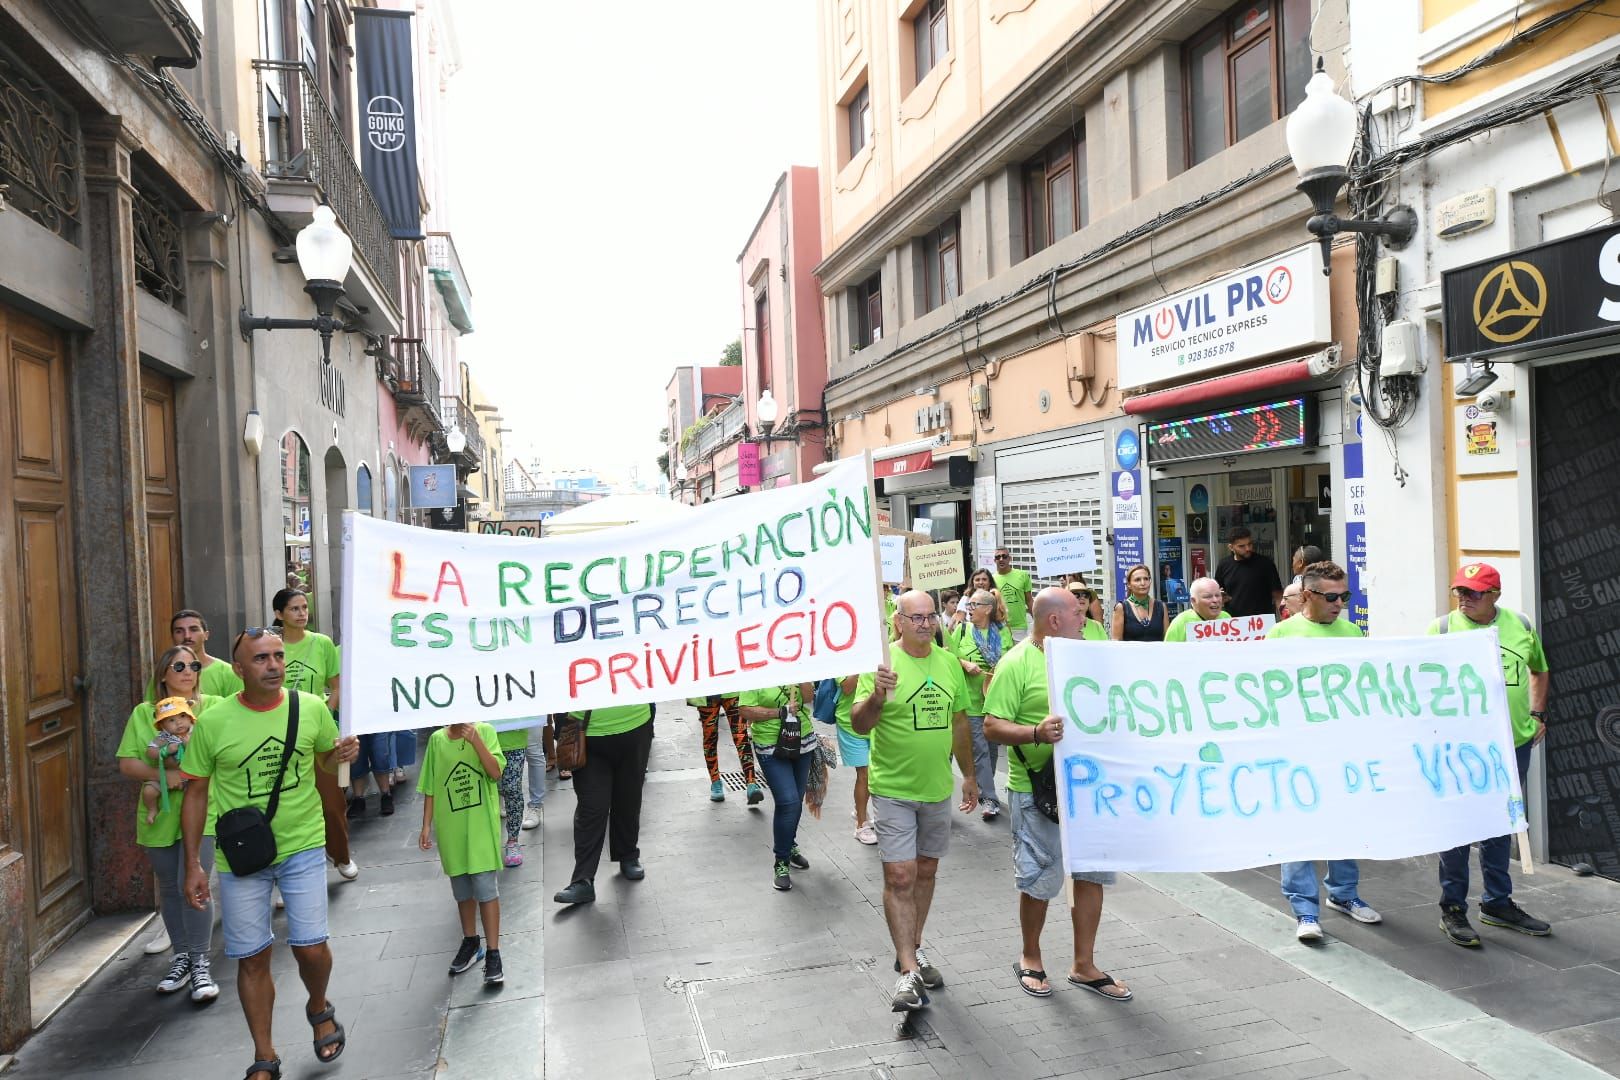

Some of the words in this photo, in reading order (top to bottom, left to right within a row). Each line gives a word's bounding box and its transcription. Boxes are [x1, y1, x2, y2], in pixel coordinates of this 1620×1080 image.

[368, 115, 405, 132] GOIKO
[1151, 339, 1186, 357] SERVICIO
[1187, 327, 1224, 346] TECNICO
[1226, 315, 1268, 336] EXPRESS
[1187, 351, 1202, 363] 928
[1203, 347, 1218, 360] 365
[1218, 341, 1235, 355] 878
[387, 551, 469, 607] LA
[498, 484, 873, 607] RECUPERACIÓN
[937, 548, 957, 557] SALUD
[926, 566, 958, 578] INVERSIÓN
[390, 611, 454, 648] ES
[469, 614, 533, 652] UN
[553, 565, 807, 645] DERECHO
[1193, 618, 1241, 639] SOLOS
[391, 672, 455, 713] NO
[476, 669, 536, 707] UN
[1062, 676, 1193, 738] CASA
[1198, 661, 1488, 730] ESPERANZA
[1344, 759, 1387, 793] DE
